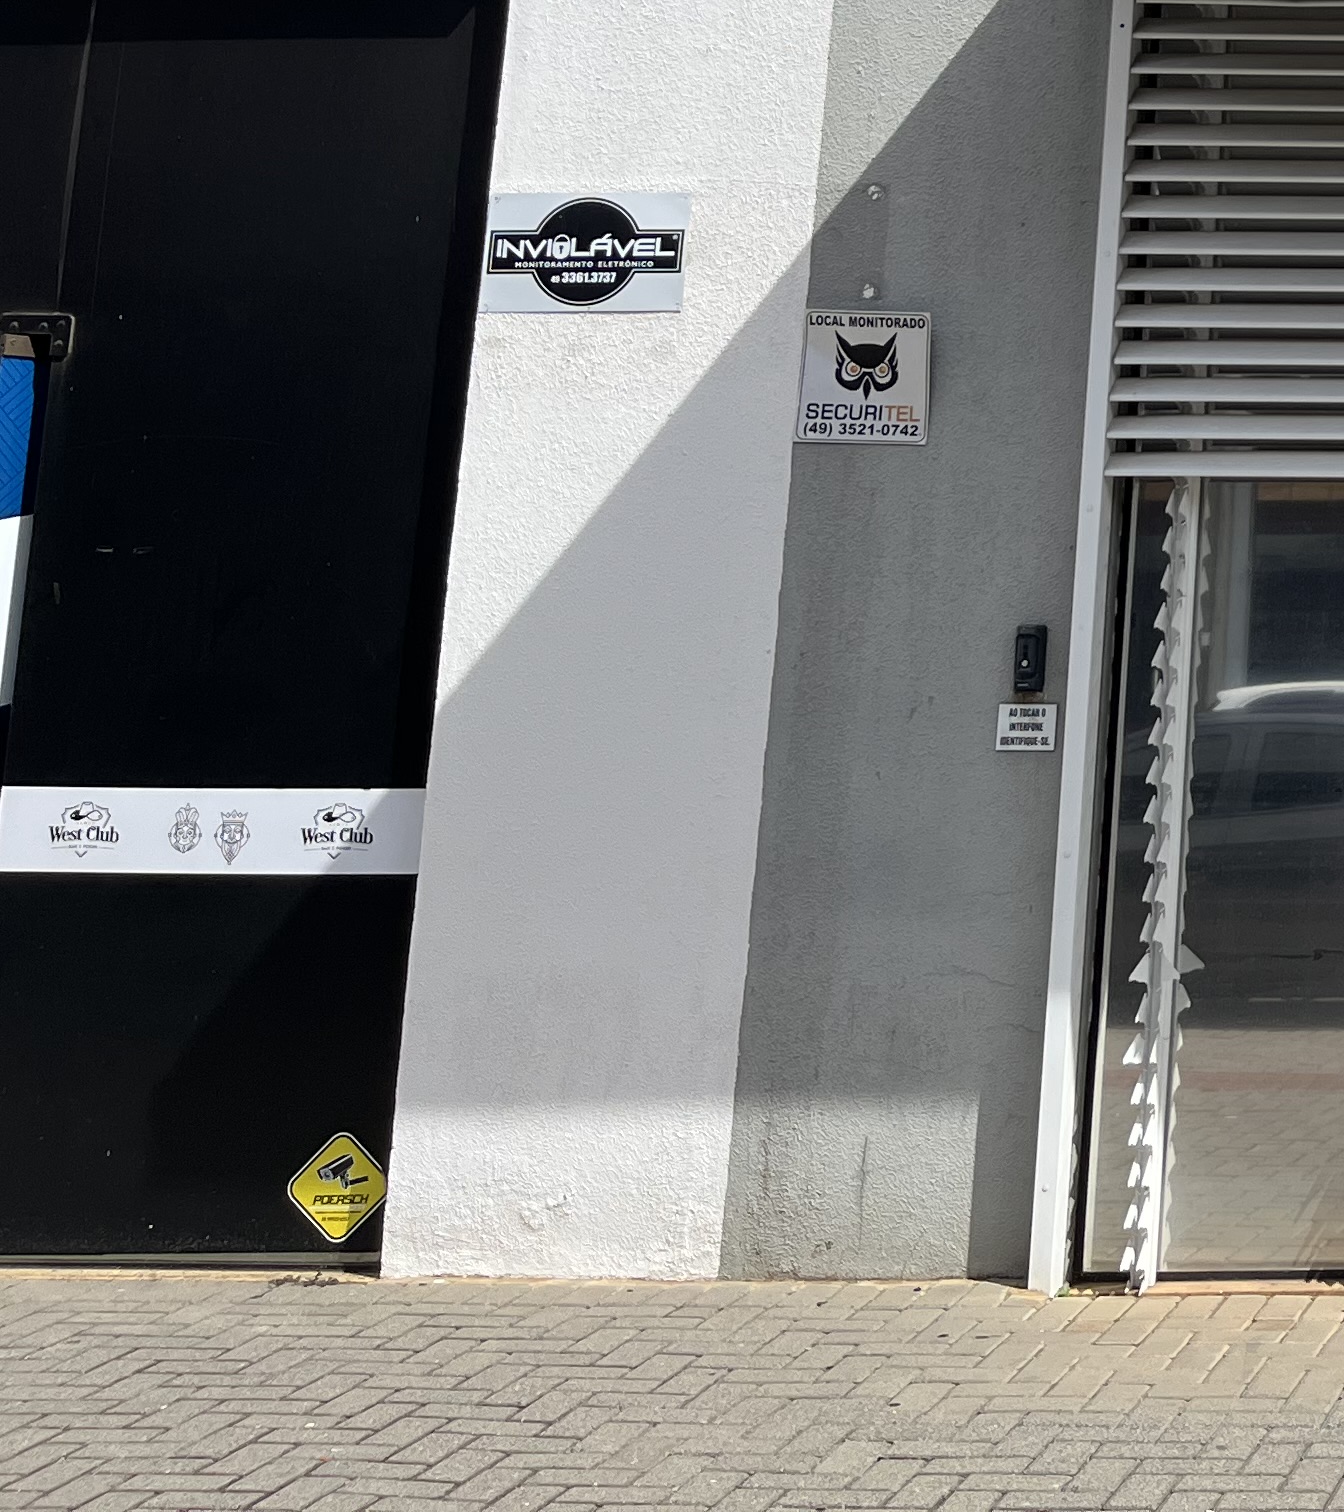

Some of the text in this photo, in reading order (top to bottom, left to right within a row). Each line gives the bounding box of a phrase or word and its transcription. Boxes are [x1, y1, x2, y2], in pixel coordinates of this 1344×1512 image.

[514, 259, 655, 269] MONITORAMENTO ELETRÔNICO
[809, 314, 926, 329] LOCAL MONITORADO
[805, 403, 921, 423] SECURITEL
[803, 422, 920, 438] (49) 3521-0742
[48, 825, 120, 843] West Club
[300, 826, 374, 845] West Club
